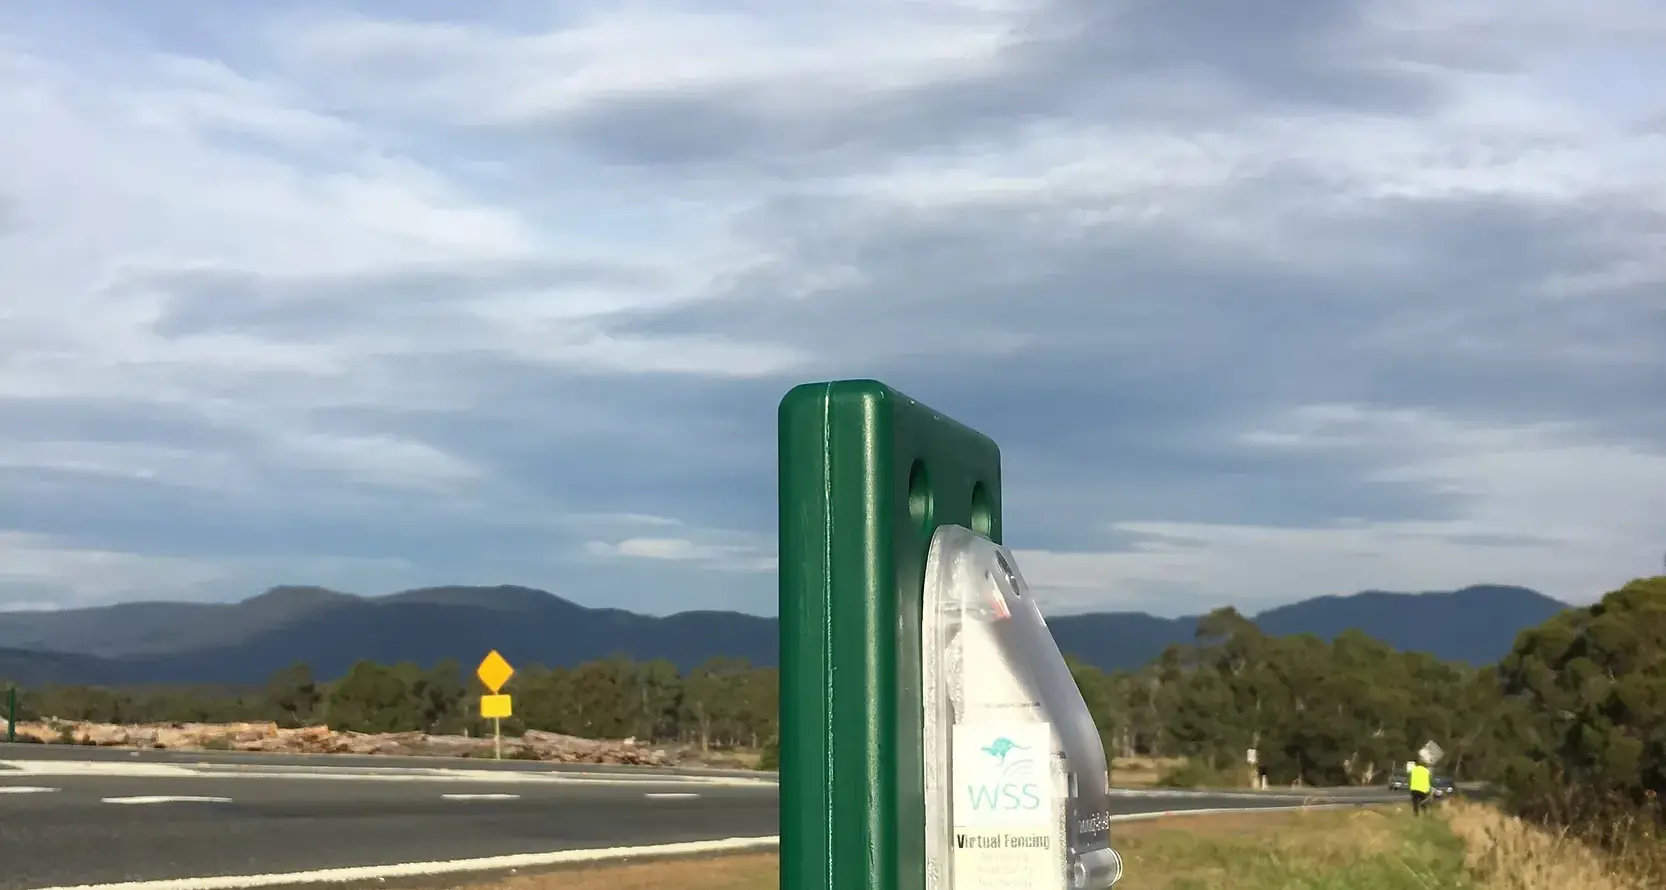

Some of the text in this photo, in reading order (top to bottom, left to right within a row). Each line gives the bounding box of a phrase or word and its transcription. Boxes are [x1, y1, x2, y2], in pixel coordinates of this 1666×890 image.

[967, 783, 1040, 811] WSS
[957, 833, 1050, 850] Virtual Fencing
